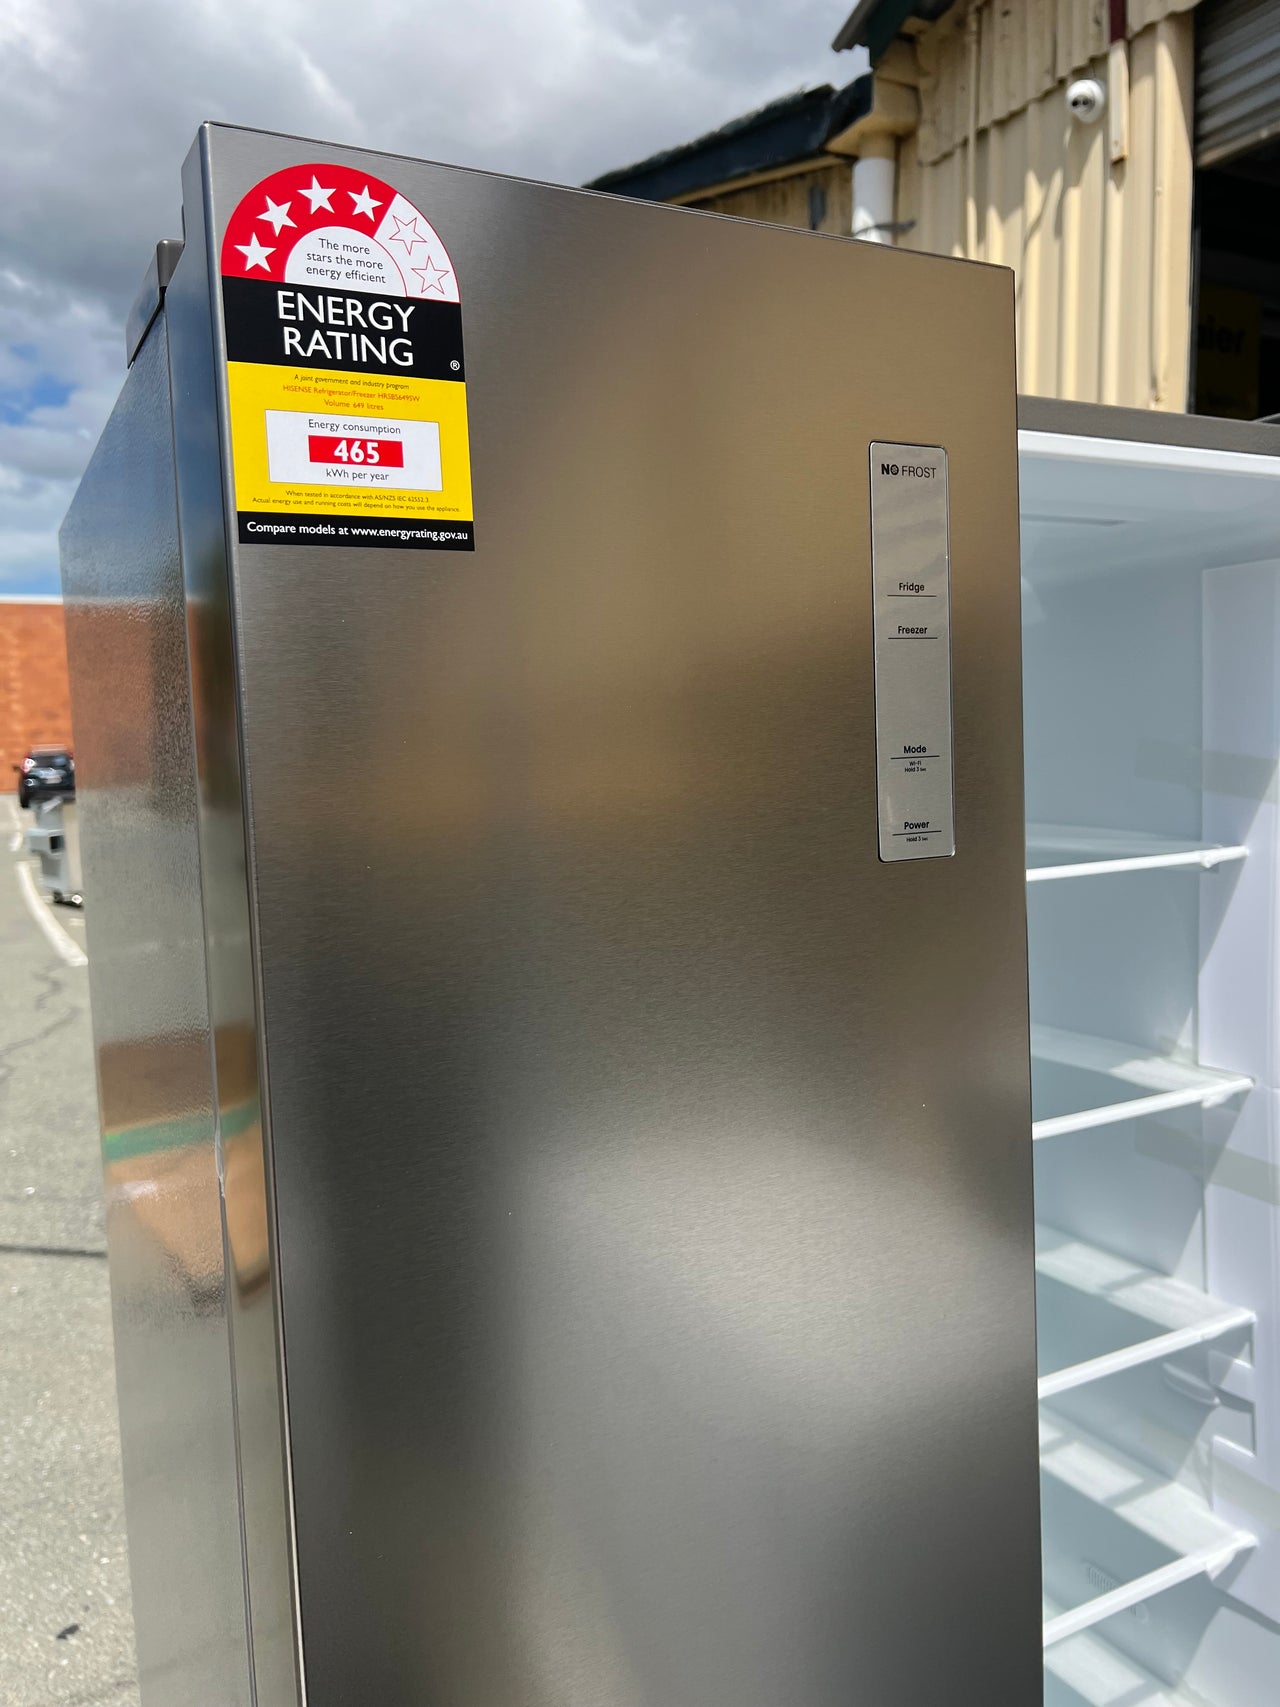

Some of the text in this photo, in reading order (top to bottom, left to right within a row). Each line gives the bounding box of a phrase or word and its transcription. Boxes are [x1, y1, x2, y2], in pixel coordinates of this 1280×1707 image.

[318, 238, 370, 254] The more
[306, 253, 383, 270] stars the more
[306, 266, 386, 284] energy efficient
[277, 290, 415, 332] ENERGY
[283, 326, 414, 366] RATING
[282, 385, 312, 393] HISENSE
[362, 380, 384, 388] industry
[324, 399, 350, 408] Volume
[308, 418, 401, 435] Energy consumption
[334, 440, 380, 464] 465
[326, 468, 390, 482] kWh per year
[881, 464, 937, 478] NO FROST
[247, 521, 468, 540] Compare models at www.energyrating.gov.au
[898, 582, 925, 594] Fridge
[898, 626, 928, 635] Freezer
[904, 745, 927, 754] Mode
[904, 822, 930, 830] Power
